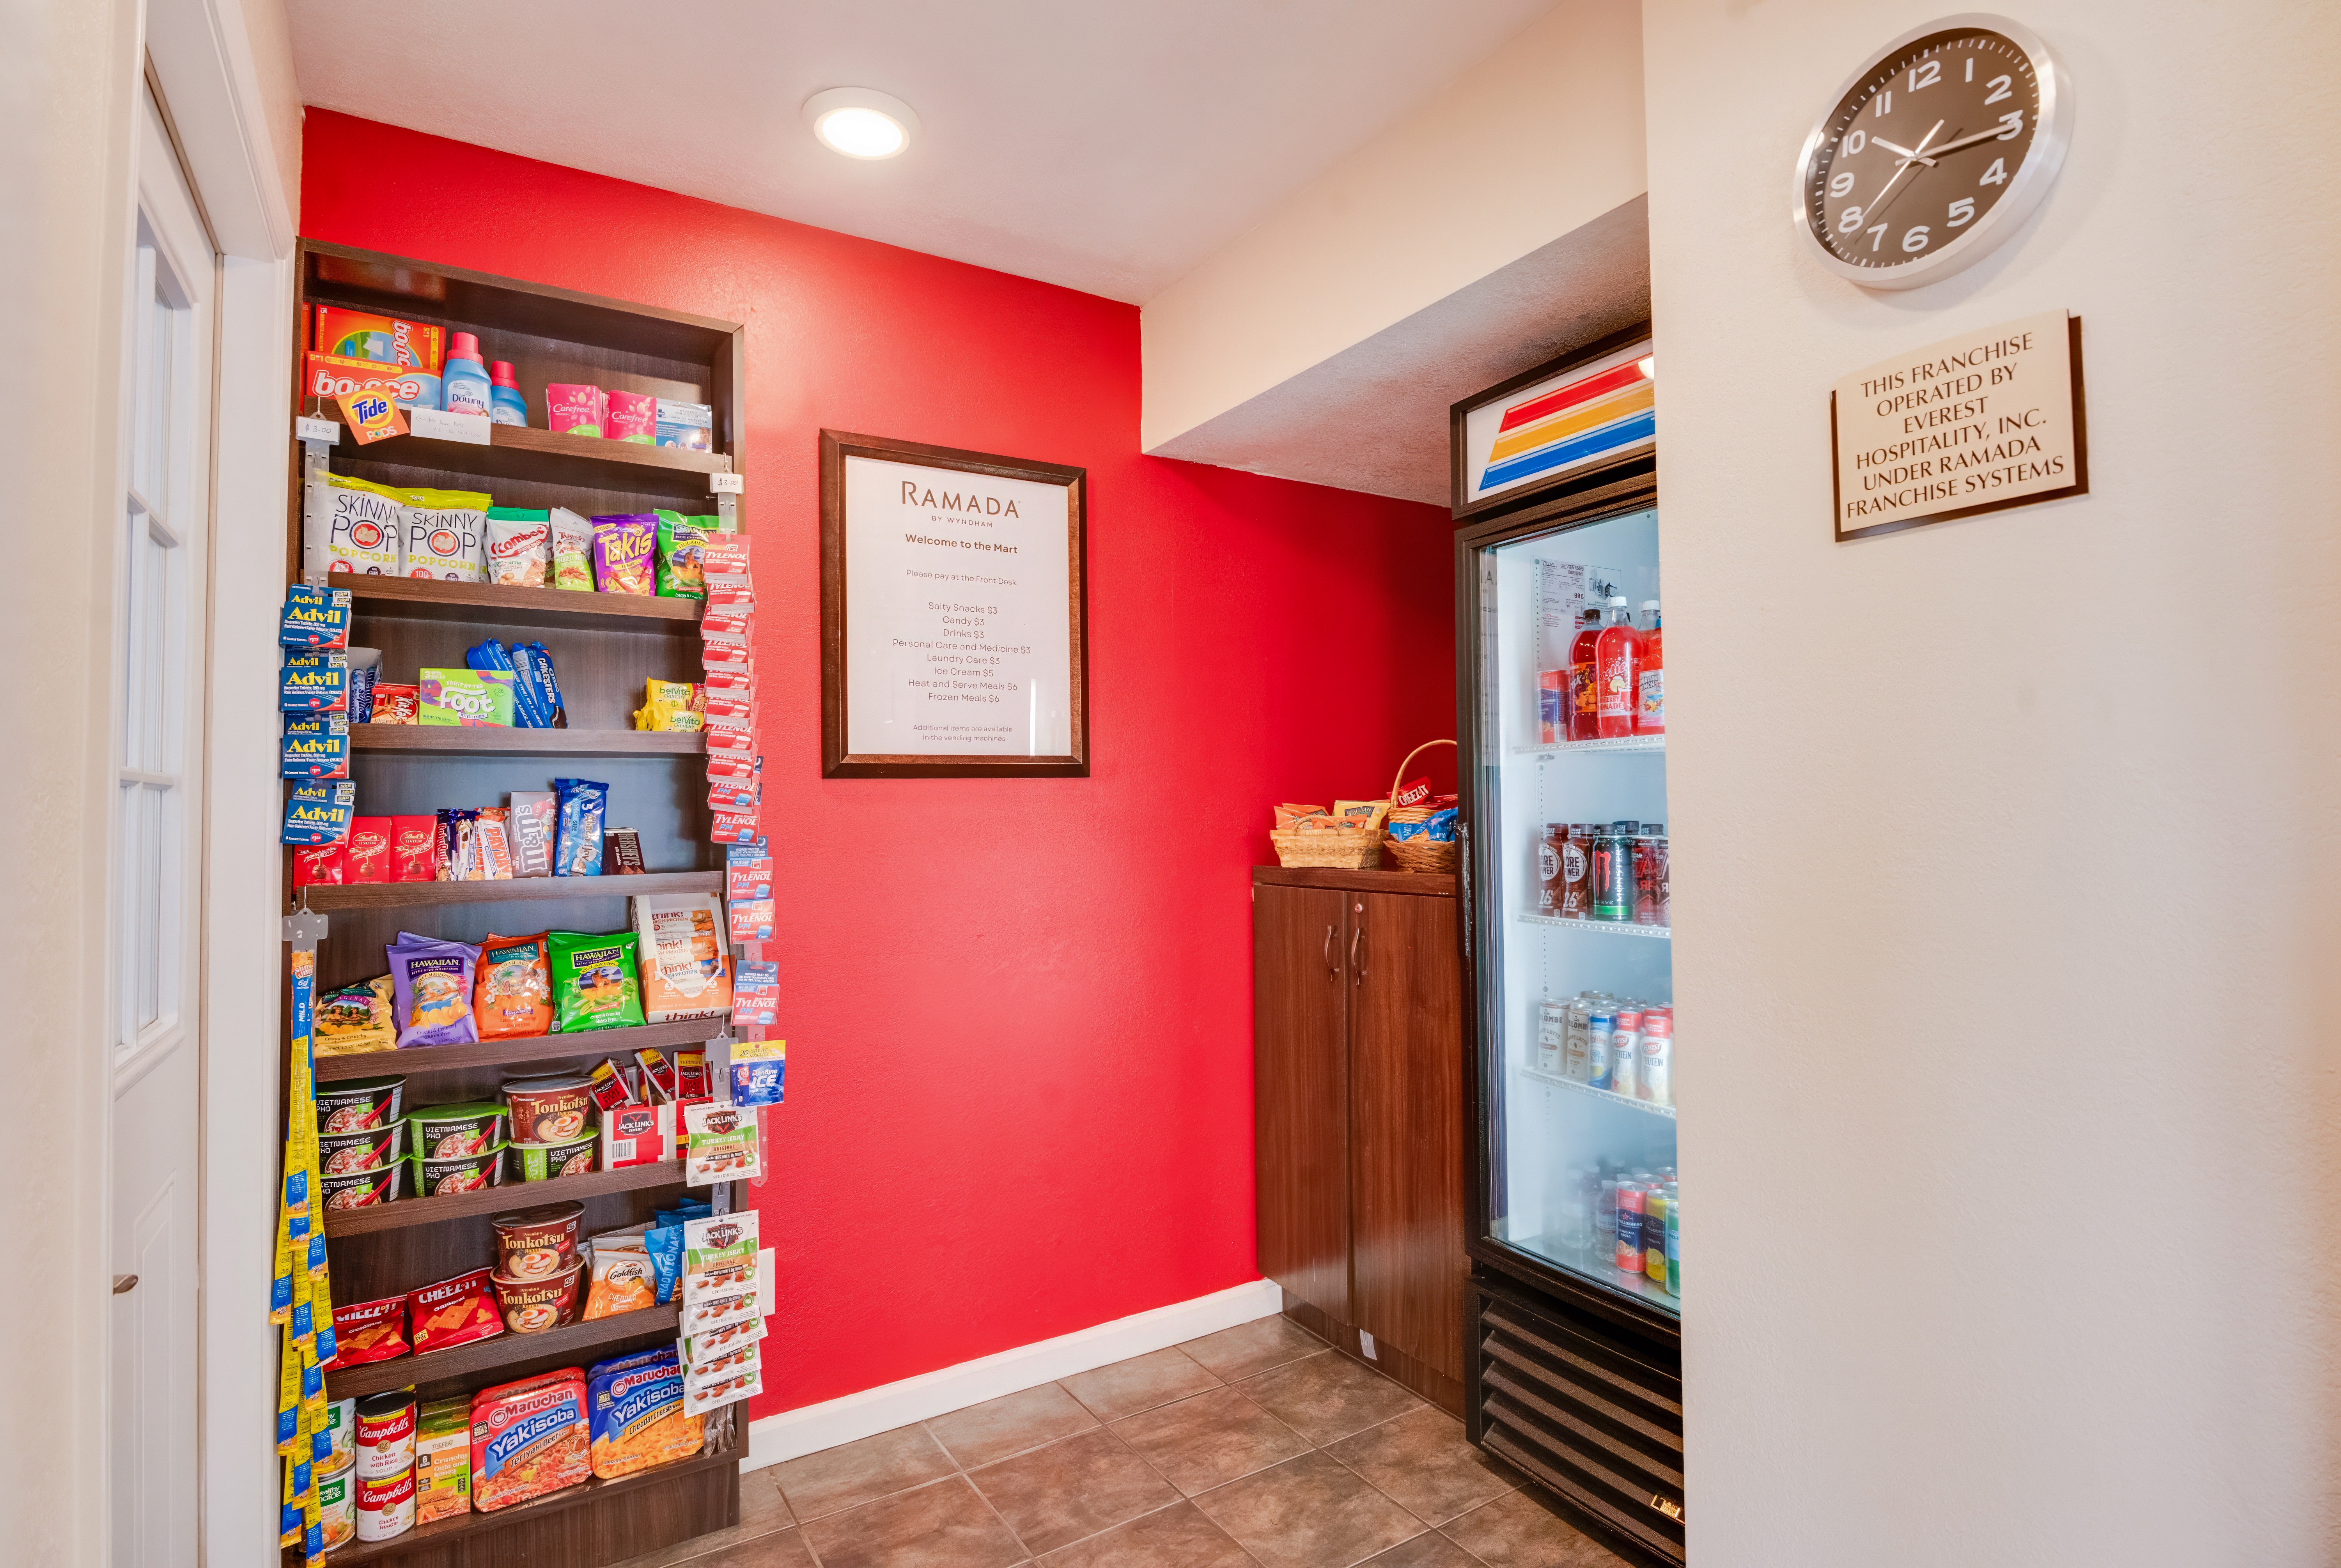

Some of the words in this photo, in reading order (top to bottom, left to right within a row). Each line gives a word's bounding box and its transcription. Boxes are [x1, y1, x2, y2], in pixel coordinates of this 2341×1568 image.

[1909, 60, 1941, 92] 12
[1965, 58, 1973, 82] 1
[1985, 75, 2012, 105] 2
[1875, 91, 1891, 117] 11
[1996, 110, 2023, 140] 3
[1842, 130, 1865, 157] 10
[1979, 157, 2007, 186] 4
[1829, 172, 1854, 197] 9
[1838, 206, 1863, 233] 8
[1947, 197, 1974, 227] 5
[1867, 223, 1887, 251] 7
[1902, 225, 1930, 252] 6
[1861, 372, 1905, 398] THIS
[1912, 332, 2033, 384] FRANCHISE
[1877, 374, 1982, 416] OPERATED
[1991, 362, 2017, 386] BY
[452, 394, 484, 409] Downy
[553, 404, 590, 414] Carefree
[352, 398, 387, 425] Tide
[612, 411, 647, 423] Carefree
[1904, 396, 1988, 434] EVEREST
[366, 427, 397, 440] PODS
[1856, 421, 1990, 470] HOSPITALITY,
[1999, 408, 2047, 434] INC.
[1863, 460, 1932, 491] UNDER
[1940, 435, 2041, 473] RAMADA
[1847, 479, 1958, 518] FRANCHISE
[1965, 455, 2065, 493] SYSTEMS
[902, 481, 1019, 519] RAMADA
[947, 517, 993, 528] WYNDHAM
[331, 514, 397, 552] POP
[410, 526, 476, 559] POP
[905, 534, 957, 547] Welcome
[960, 540, 971, 549] to
[974, 542, 991, 551] the
[994, 543, 1018, 554] Mart
[329, 545, 396, 563] POPCORN
[705, 551, 747, 559] TYLENOL
[408, 555, 475, 571] POPCORN
[906, 569, 932, 578] Please
[976, 576, 996, 584] Front
[291, 595, 323, 605] Advil
[287, 607, 341, 624] Advil
[928, 602, 951, 612] Salty
[953, 604, 985, 614] Snacks
[987, 606, 998, 615] $3
[943, 616, 972, 627] Candy
[974, 618, 985, 626] $3
[943, 628, 972, 638] Drinks
[973, 630, 984, 639] $3
[893, 639, 933, 649] Personal
[936, 641, 958, 650] Care
[960, 643, 977, 651] and
[979, 644, 1019, 653] Medicine
[1020, 646, 1031, 654] $3
[288, 657, 319, 666] Advil
[927, 653, 964, 664] Laundry
[966, 656, 987, 664] Care
[989, 657, 1000, 665] $3
[286, 672, 339, 685] Advil
[934, 667, 948, 675] Ice
[950, 668, 981, 677] Cream
[983, 669, 994, 678] $5
[537, 657, 556, 704] CAKESTERS
[908, 679, 930, 688] Heat
[952, 681, 978, 689] Serve
[980, 682, 1005, 690] Meals
[1007, 683, 1018, 691] $6
[659, 686, 690, 696] belVita
[928, 693, 959, 701] Frozen
[961, 694, 987, 702] Meals
[989, 695, 1000, 703] $6
[288, 722, 320, 731] Advil
[670, 715, 700, 726] belVita
[287, 739, 340, 753] Advil
[294, 787, 326, 798] Advil
[291, 805, 345, 822] Advil
[715, 814, 758, 826] TYLENOL
[1565, 856, 1579, 868] ORE
[732, 872, 772, 883] TYLENOL
[732, 914, 773, 924] TYLENOL
[411, 959, 461, 969] HAWAIIAN
[735, 998, 777, 1008] TYLENOL
[665, 1011, 715, 1021] think!
[751, 1075, 777, 1088] ICE
[531, 1096, 588, 1115] Tonkotsu
[425, 1122, 478, 1133] VIETNAMESE
[702, 1117, 720, 1127] JACK
[320, 1137, 371, 1147] IETNAMESE
[702, 1137, 726, 1145] TURKEY
[551, 1141, 593, 1157] VIETNAMESE
[425, 1162, 478, 1173] VIETNAMESE
[503, 1232, 564, 1249] Tonkotsu
[610, 1267, 643, 1280] Goldfish
[500, 1288, 562, 1305] Tonkotsu
[506, 1389, 573, 1417] Maruchan
[613, 1382, 684, 1425] Yakisoba
[360, 1416, 409, 1439] Campbell's
[629, 1415, 653, 1435] Cheddar
[491, 1408, 575, 1458] Yakisoba
[372, 1452, 396, 1461] Chicken
[422, 1455, 428, 1464] 6
[363, 1479, 412, 1503] Campbell's
